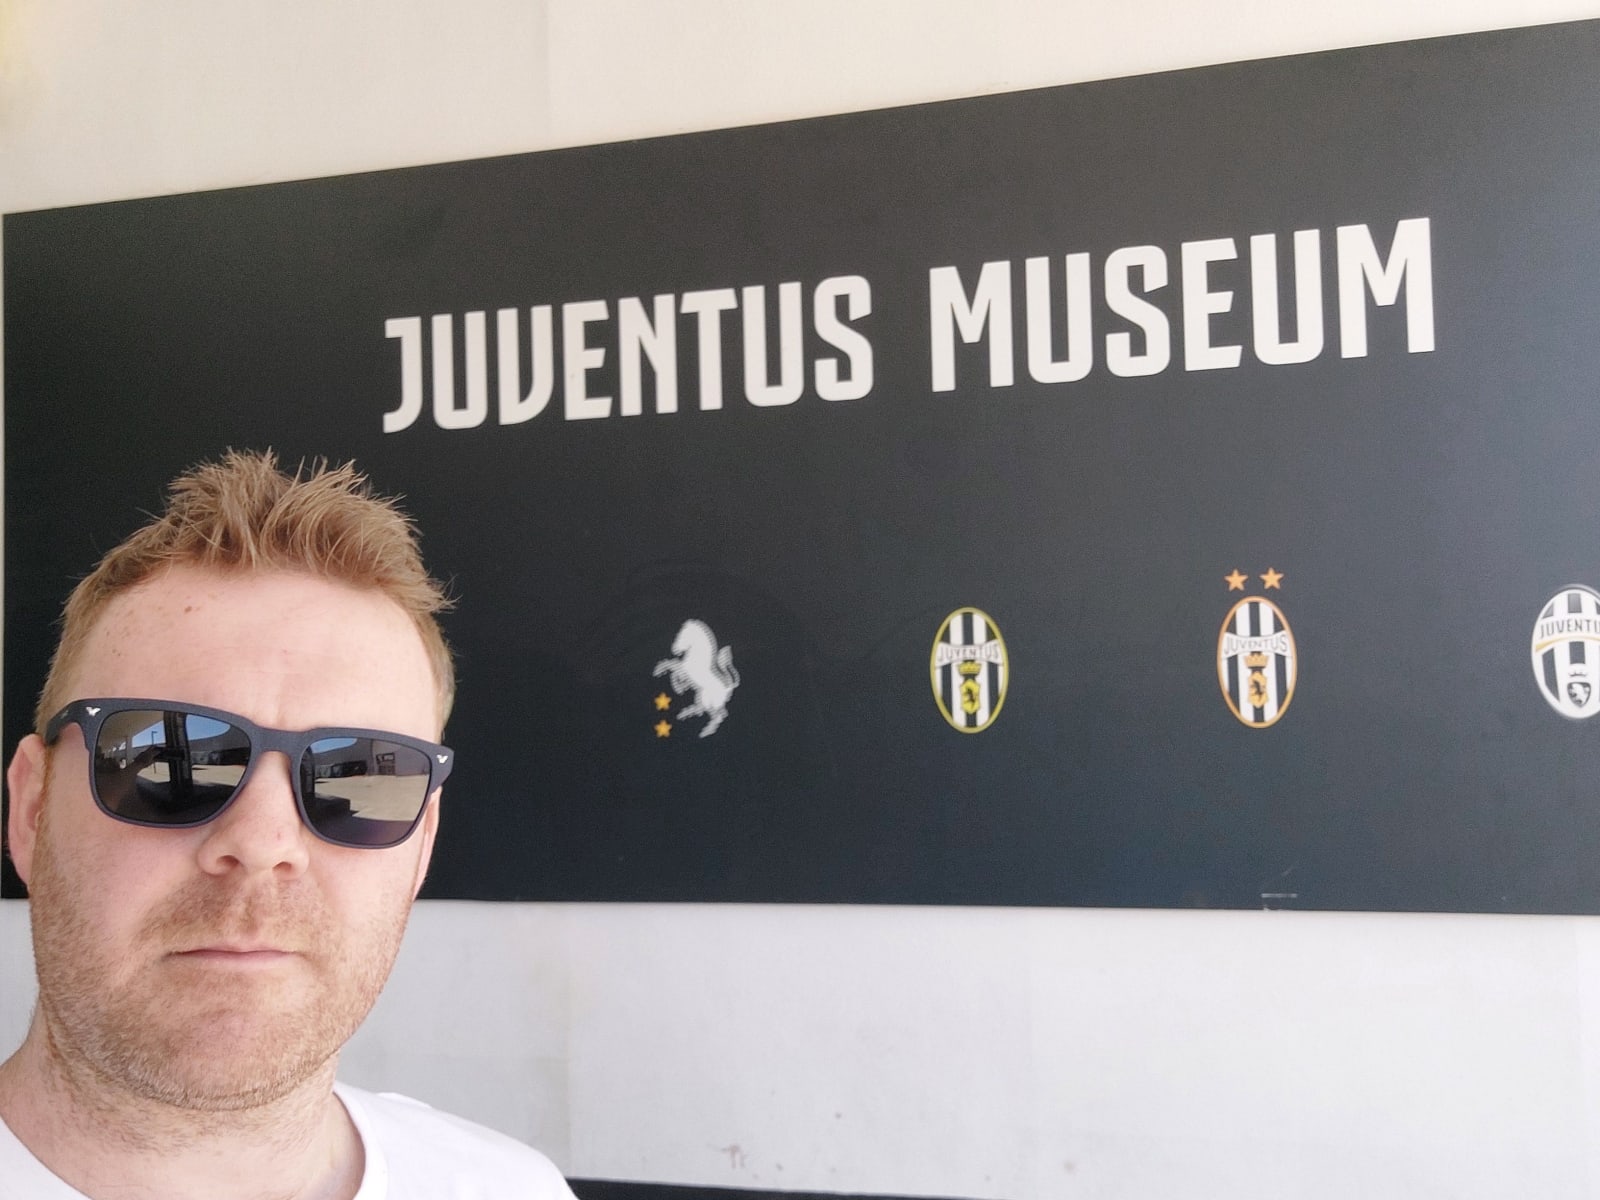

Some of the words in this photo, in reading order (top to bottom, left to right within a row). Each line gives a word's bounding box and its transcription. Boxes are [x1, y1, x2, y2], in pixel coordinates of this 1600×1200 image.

[383, 274, 874, 434] JUVENTUS
[929, 216, 1436, 393] MUSEUM
[938, 643, 999, 662] JUVENTUS
[1224, 634, 1288, 655] JUVENTUS
